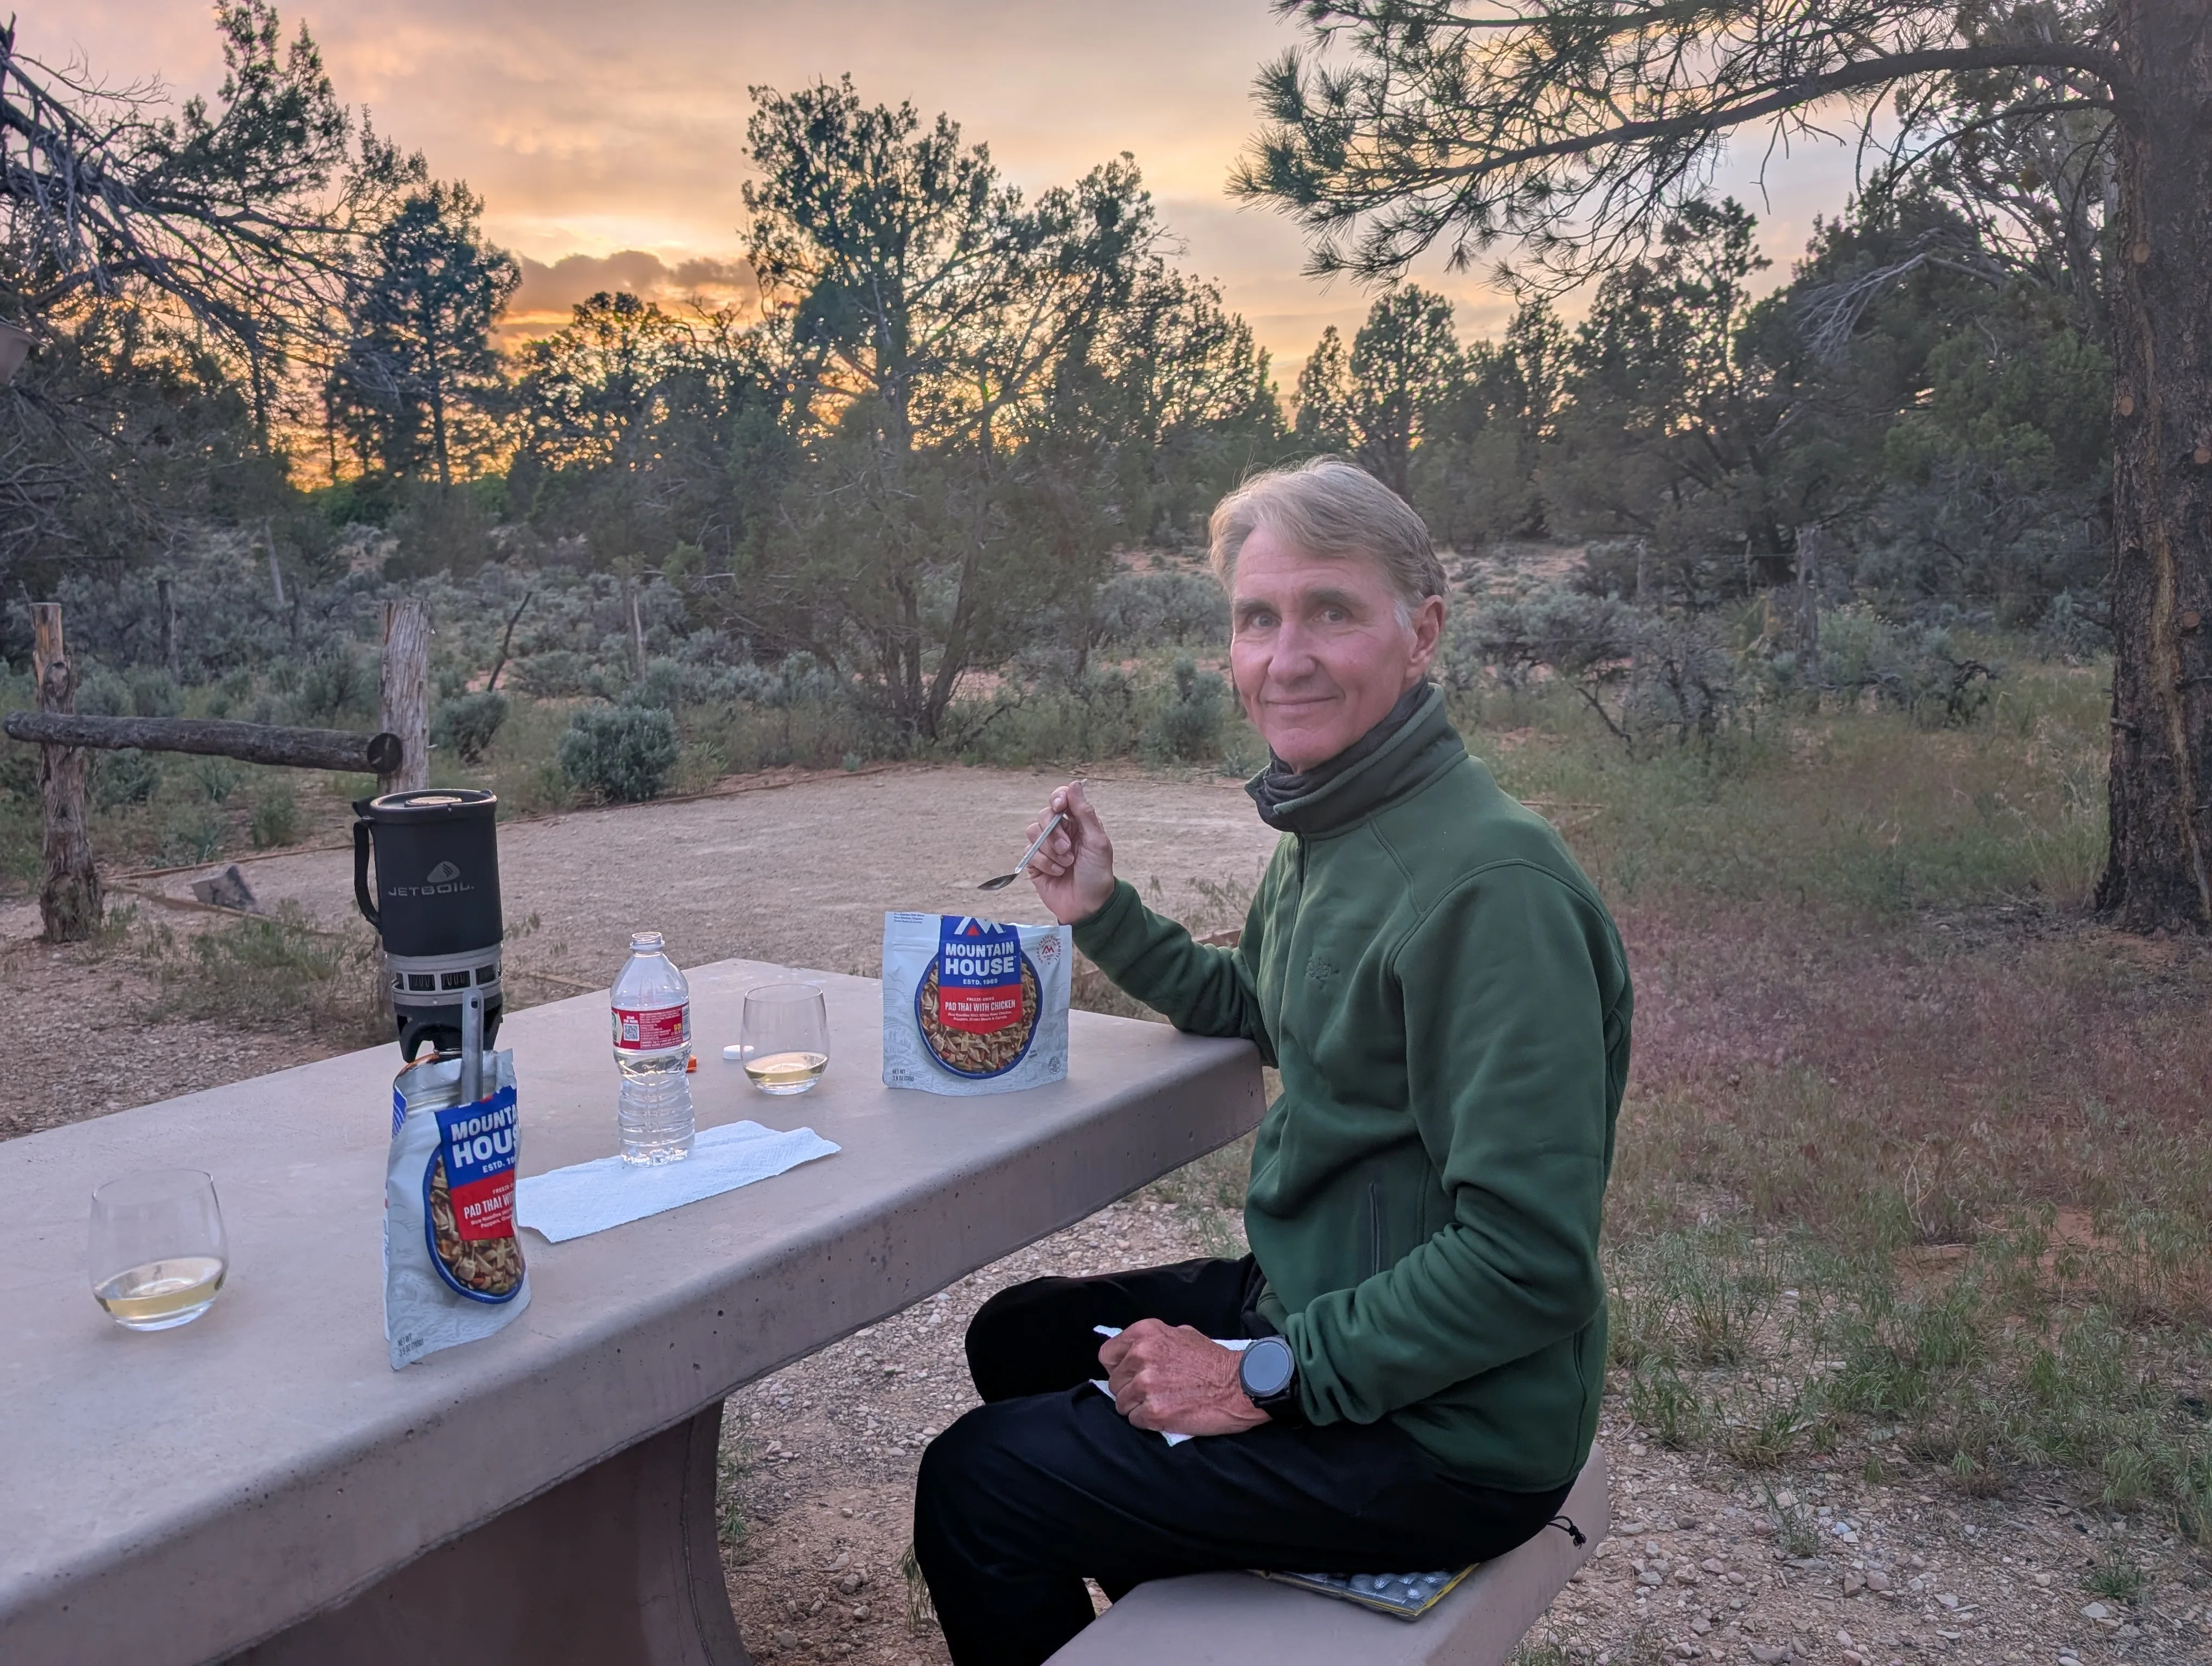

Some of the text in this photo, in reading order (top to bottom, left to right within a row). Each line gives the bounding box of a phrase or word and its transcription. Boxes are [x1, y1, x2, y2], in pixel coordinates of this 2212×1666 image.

[946, 941, 1014, 957] MOUNTAIN
[945, 956, 1015, 976] HOUSE
[945, 999, 1015, 1012] PAD THAI WITH CHICKEN
[451, 1104, 517, 1142] MOUNTA
[452, 1124, 519, 1168] HOUS
[483, 1156, 516, 1173] ESTD. 19
[464, 1202, 481, 1220] PAD
[482, 1196, 502, 1213] THAI
[502, 1191, 513, 1206] WI
